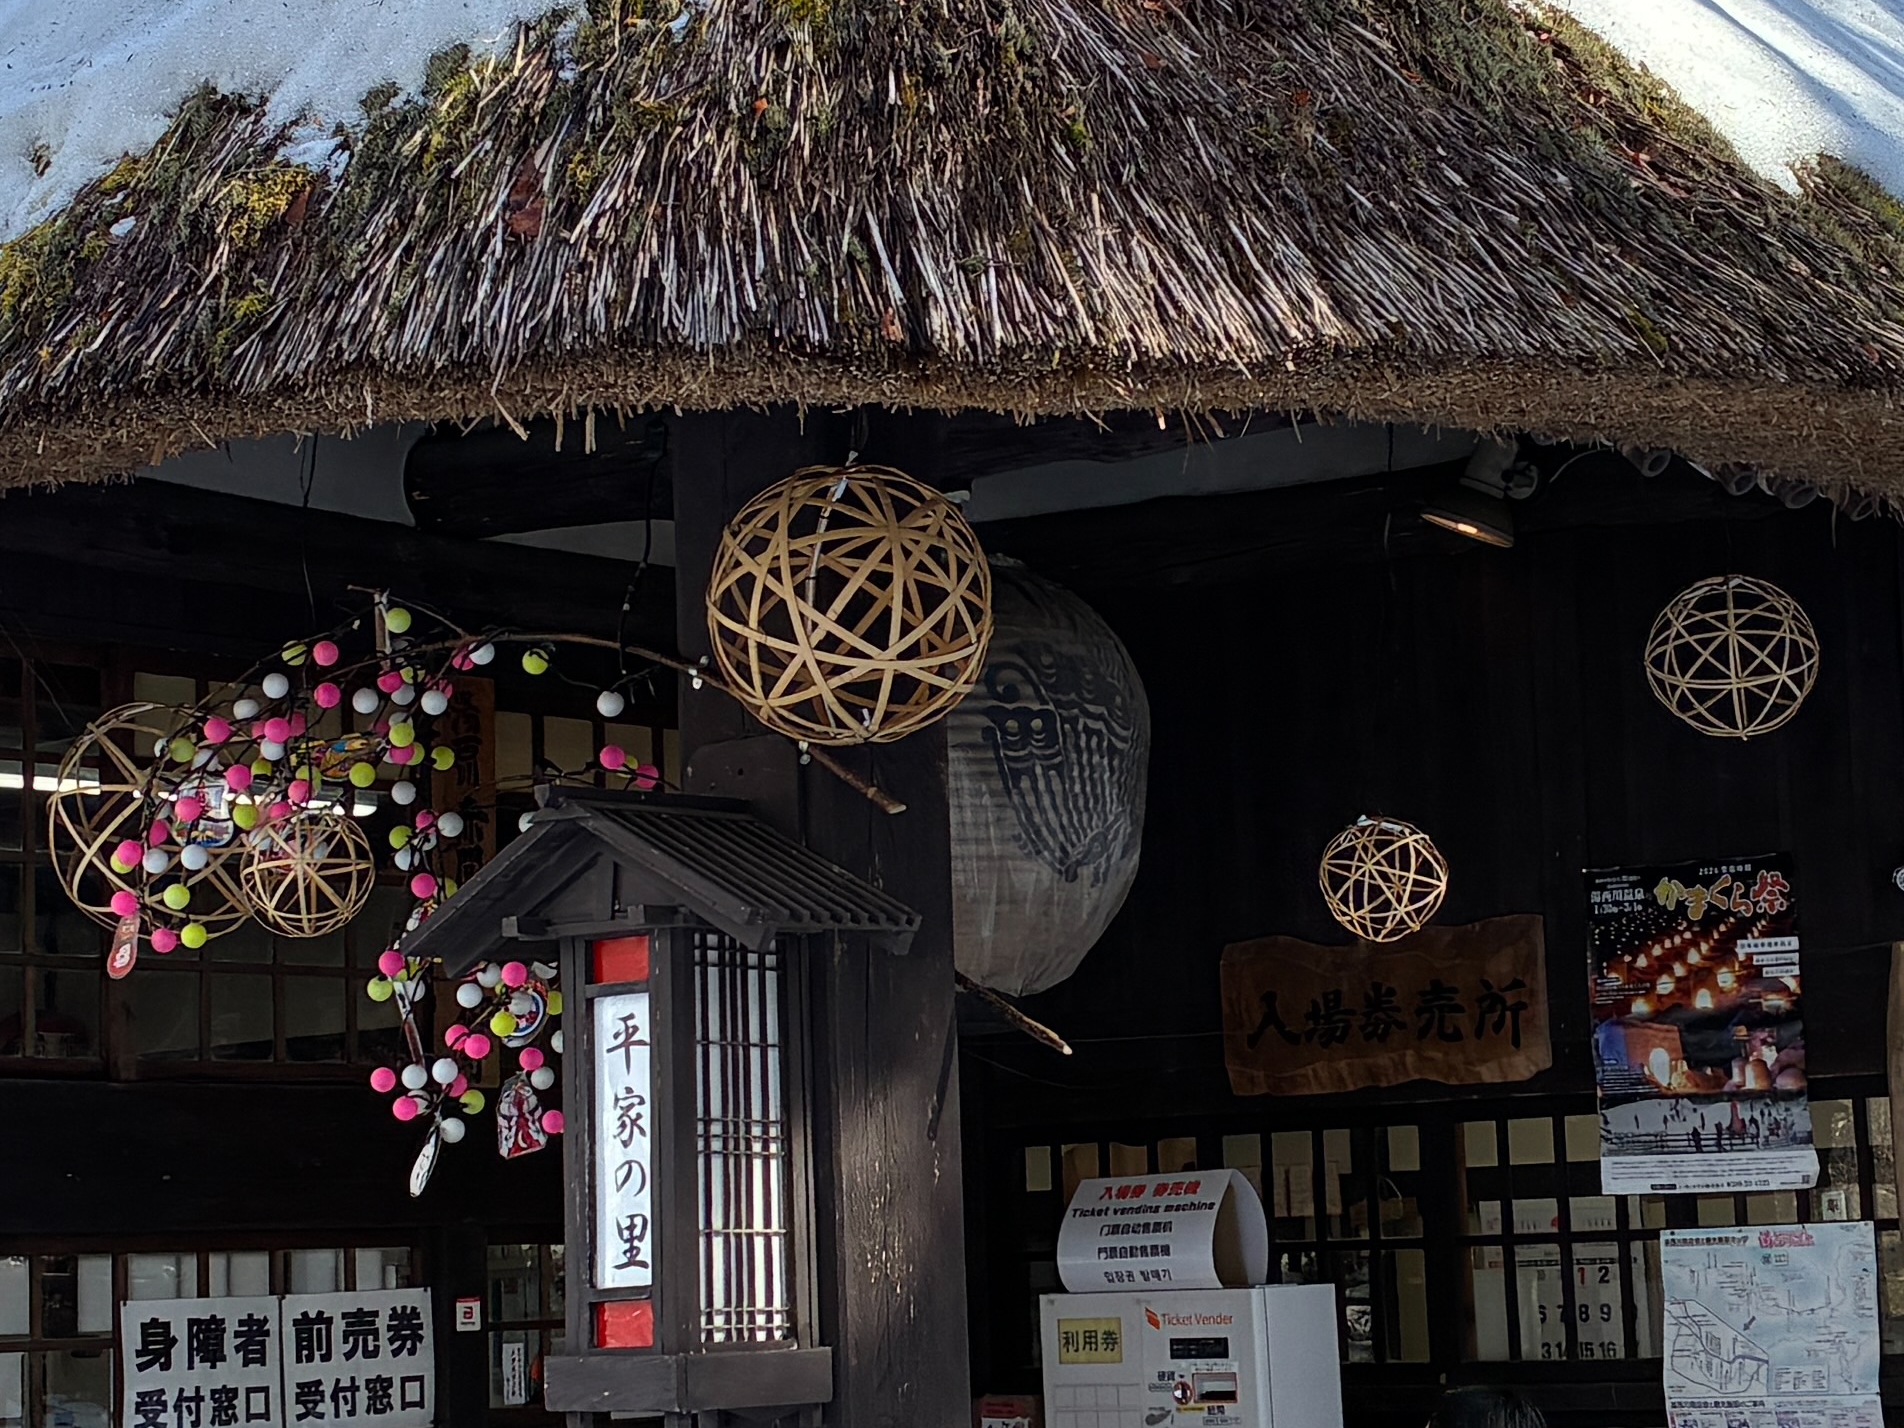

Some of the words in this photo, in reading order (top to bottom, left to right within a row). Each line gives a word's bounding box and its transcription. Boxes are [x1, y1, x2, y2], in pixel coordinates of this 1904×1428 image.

[1653, 870, 1790, 920] かまくら祭
[1246, 977, 1528, 1051] 入場券売所
[606, 1013, 652, 1271] 平家の里
[1072, 1207, 1110, 1218] Ticket
[1113, 1204, 1161, 1216] vending
[1164, 1201, 1215, 1213] machine
[1598, 1266, 1610, 1283] 2
[1161, 1313, 1193, 1326] Ticket
[1195, 1313, 1234, 1326] Vender
[1579, 1304, 1589, 1323] 8
[1600, 1303, 1611, 1322] 9
[135, 1314, 273, 1372] 身障者
[292, 1304, 426, 1368] 前売券
[1062, 1329, 1119, 1352] 利用券
[1599, 1342, 1616, 1358] 16
[295, 1373, 428, 1422] 受付窓口
